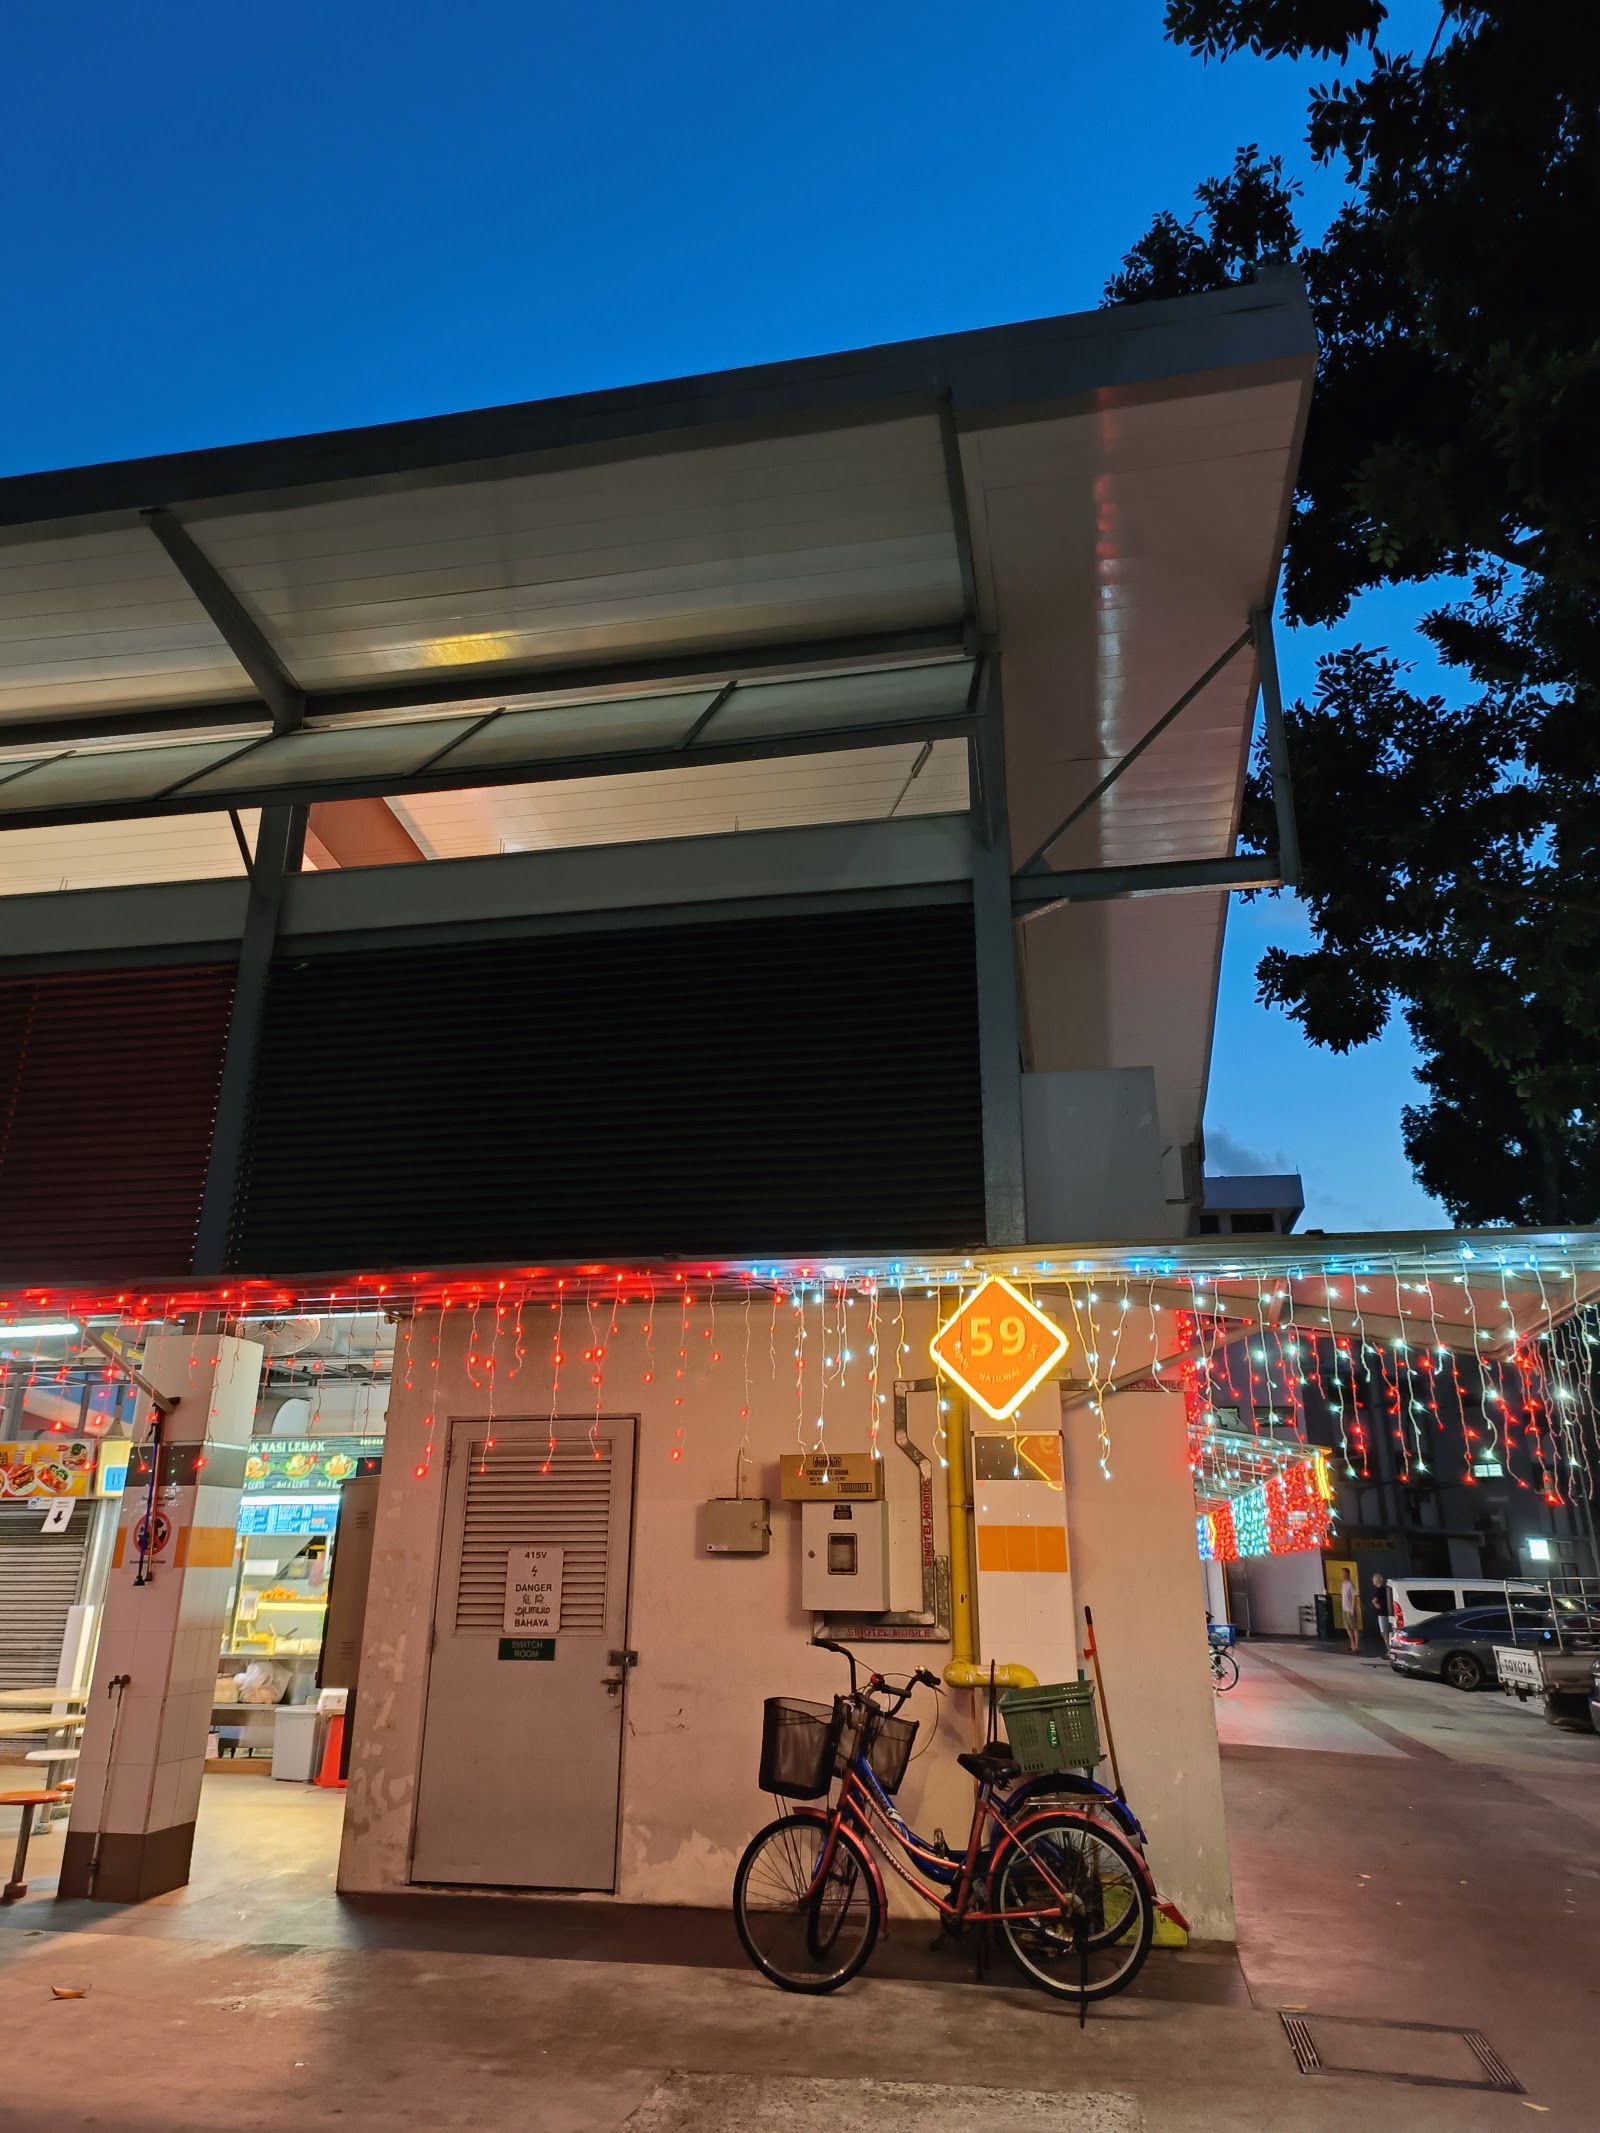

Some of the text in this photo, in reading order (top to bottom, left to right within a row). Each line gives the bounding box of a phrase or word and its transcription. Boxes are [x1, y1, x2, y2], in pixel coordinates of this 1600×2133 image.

[970, 1316, 1025, 1357] 59
[261, 1442, 286, 1453] NASI
[288, 1441, 325, 1453] LEMAK
[923, 1522, 932, 1569] SINGTEL
[524, 1551, 548, 1559] 415V
[515, 1583, 553, 1592] DANGER
[514, 1619, 549, 1627] BAHAYA
[848, 1628, 931, 1638] SINGTEL MOBILE
[511, 1640, 543, 1649] SWITCH
[514, 1650, 539, 1658] ROOM
[1503, 1659, 1534, 1676] TOYOTA
[1050, 1721, 1058, 1747] IDEAL
